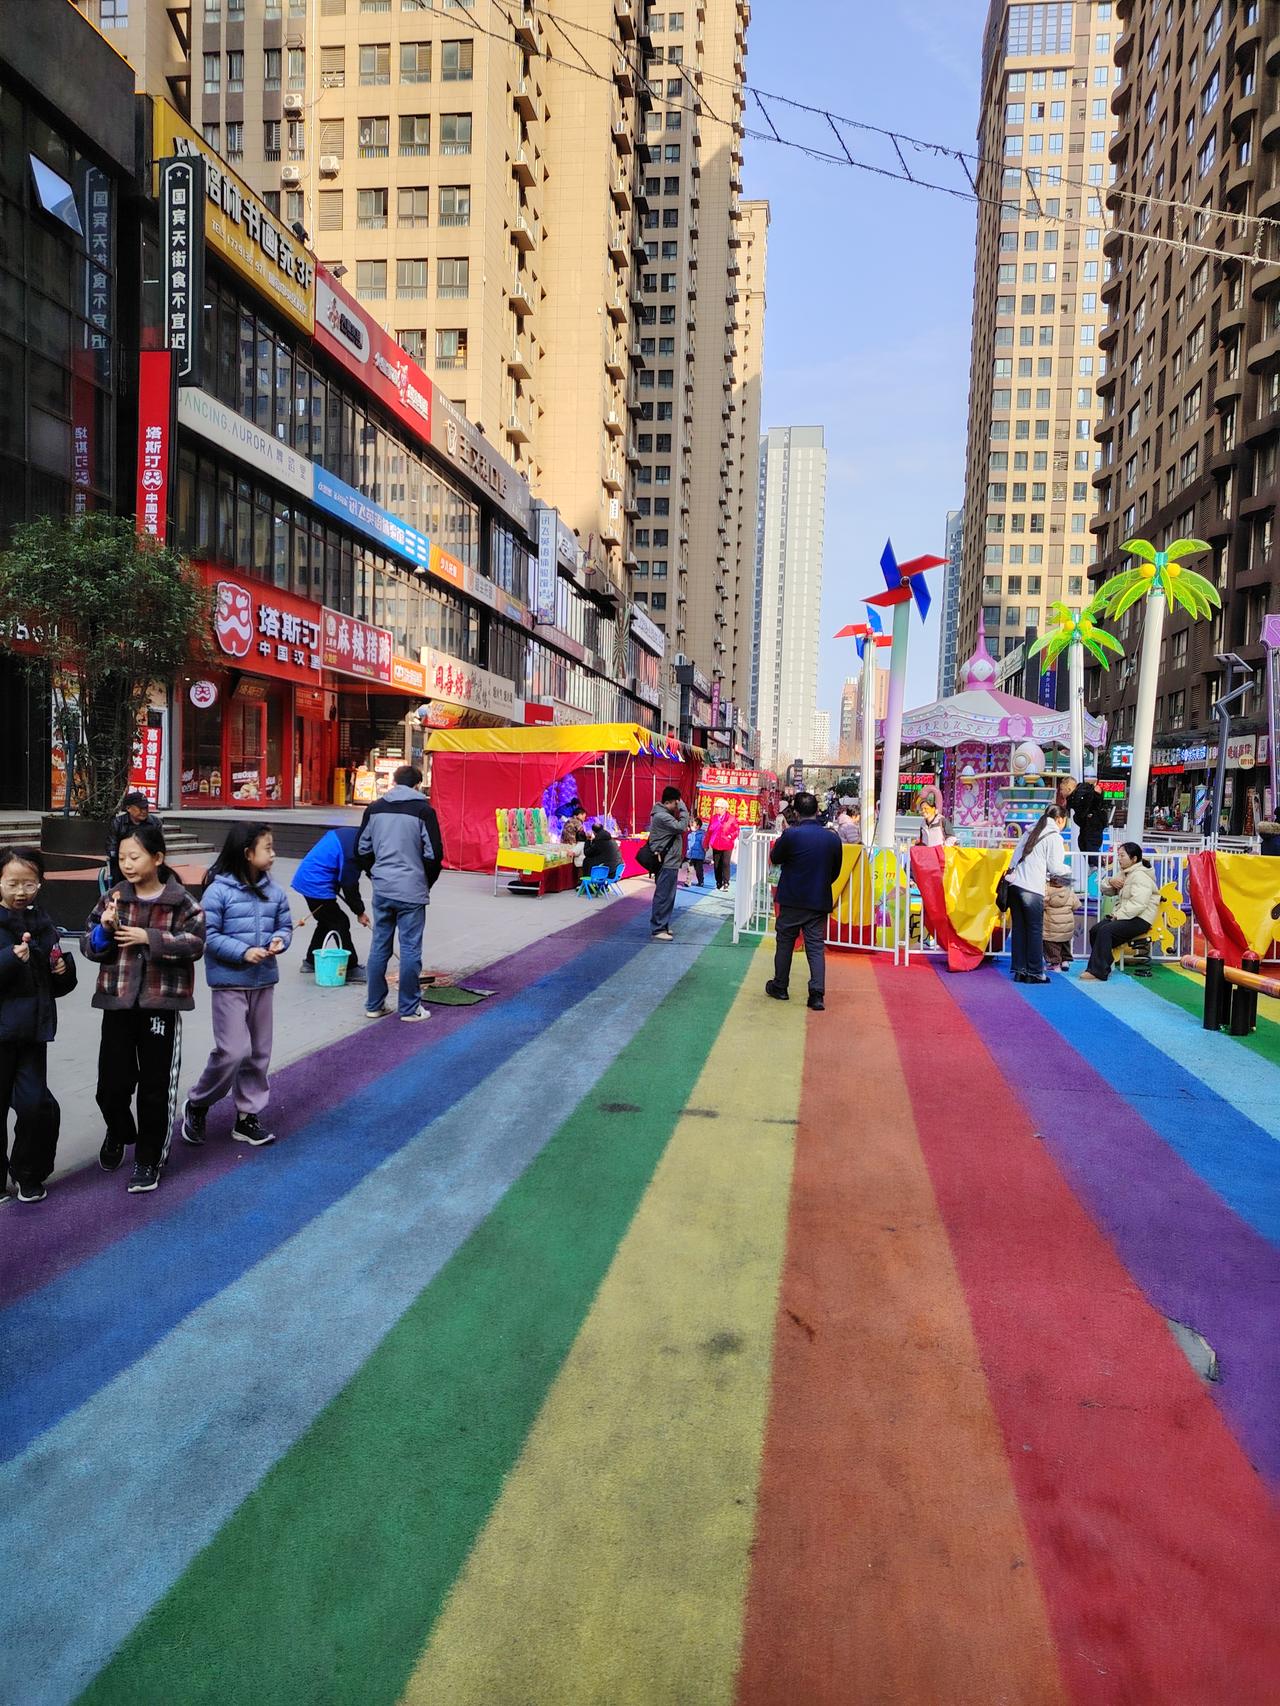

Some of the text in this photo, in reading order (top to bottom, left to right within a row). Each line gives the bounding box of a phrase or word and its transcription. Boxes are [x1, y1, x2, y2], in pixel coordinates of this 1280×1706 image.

[171, 189, 186, 350] 国宾天街食不宜迟
[144, 426, 162, 468] 塔斯汀
[259, 604, 321, 650] 塔斯汀
[337, 618, 390, 668] 麻辣猪蹄
[259, 640, 321, 670] 中国汉堡
